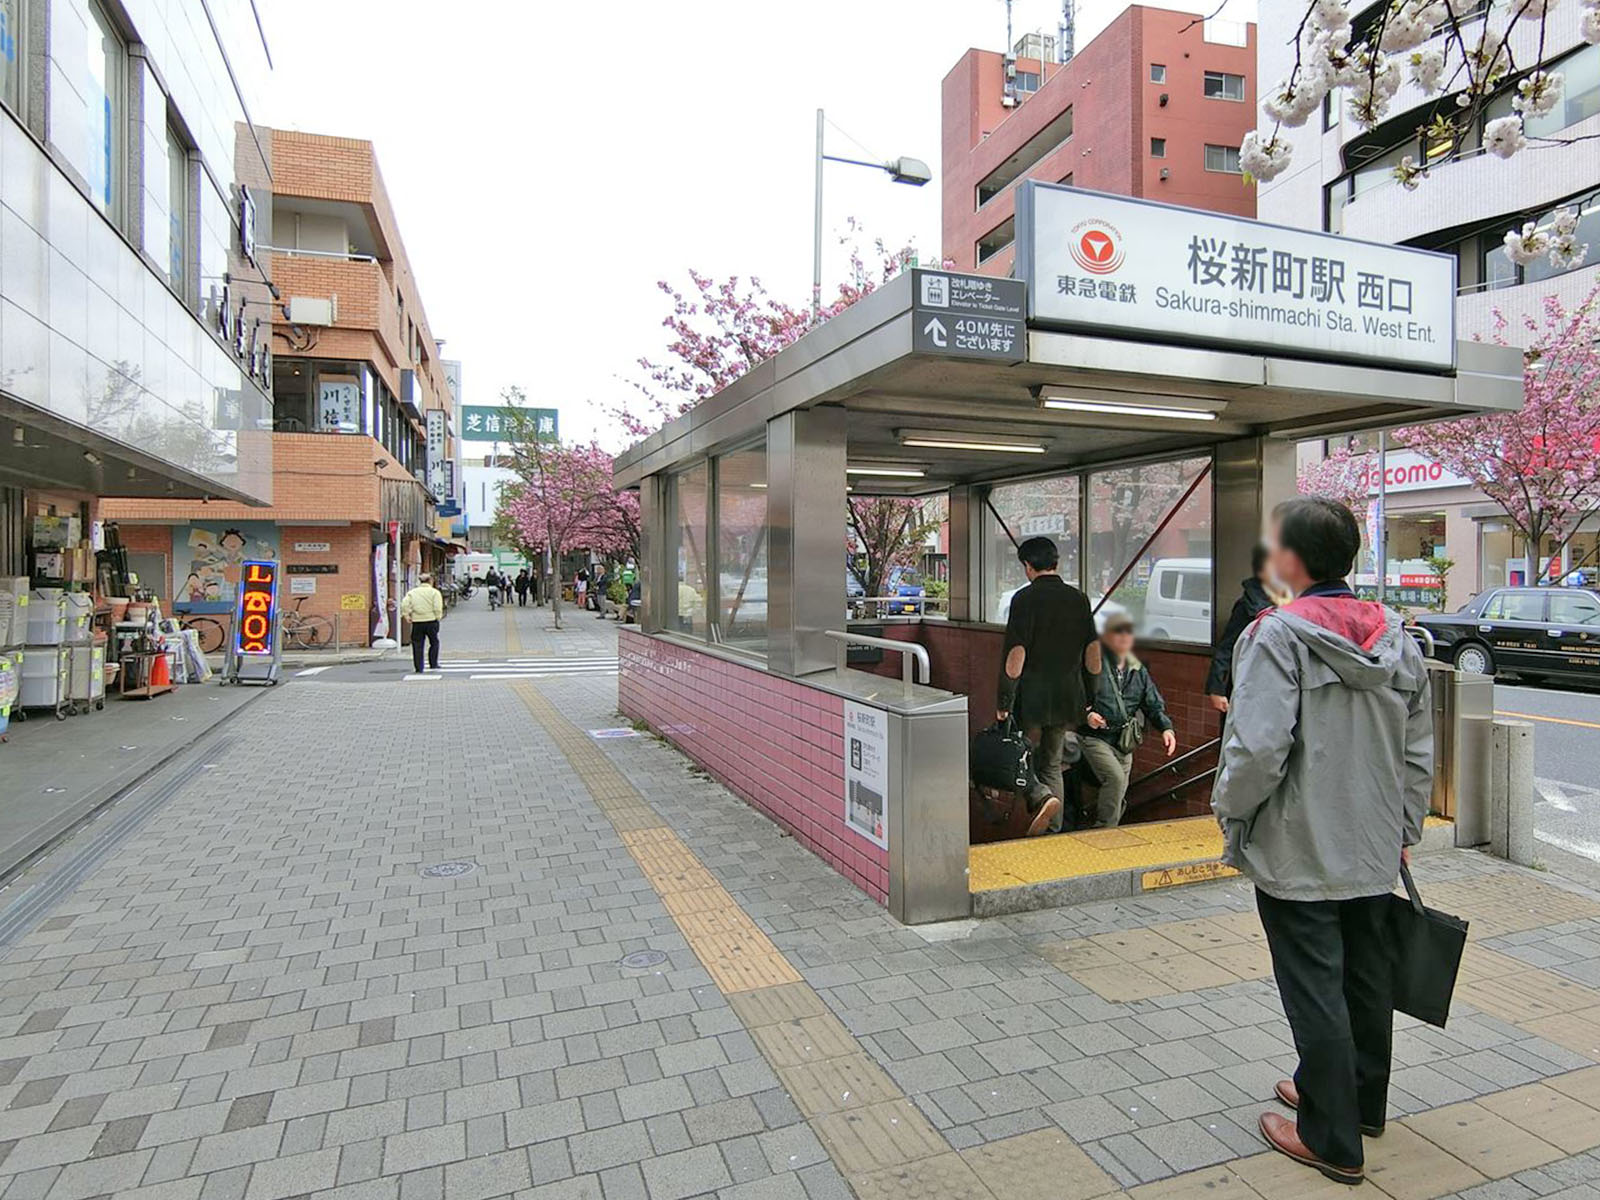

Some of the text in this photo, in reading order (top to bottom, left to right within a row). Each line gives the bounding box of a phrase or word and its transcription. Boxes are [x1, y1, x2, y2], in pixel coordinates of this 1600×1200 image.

[1188, 235, 1412, 315] 桜新町駅 西口
[951, 290, 1000, 302] エレベーター
[1057, 275, 1137, 304] 東急電鉄
[1155, 286, 1436, 343] Sakura-shimmachi Sta. West Ent.
[955, 320, 1015, 337] 40M先に
[955, 335, 1013, 352] ございます
